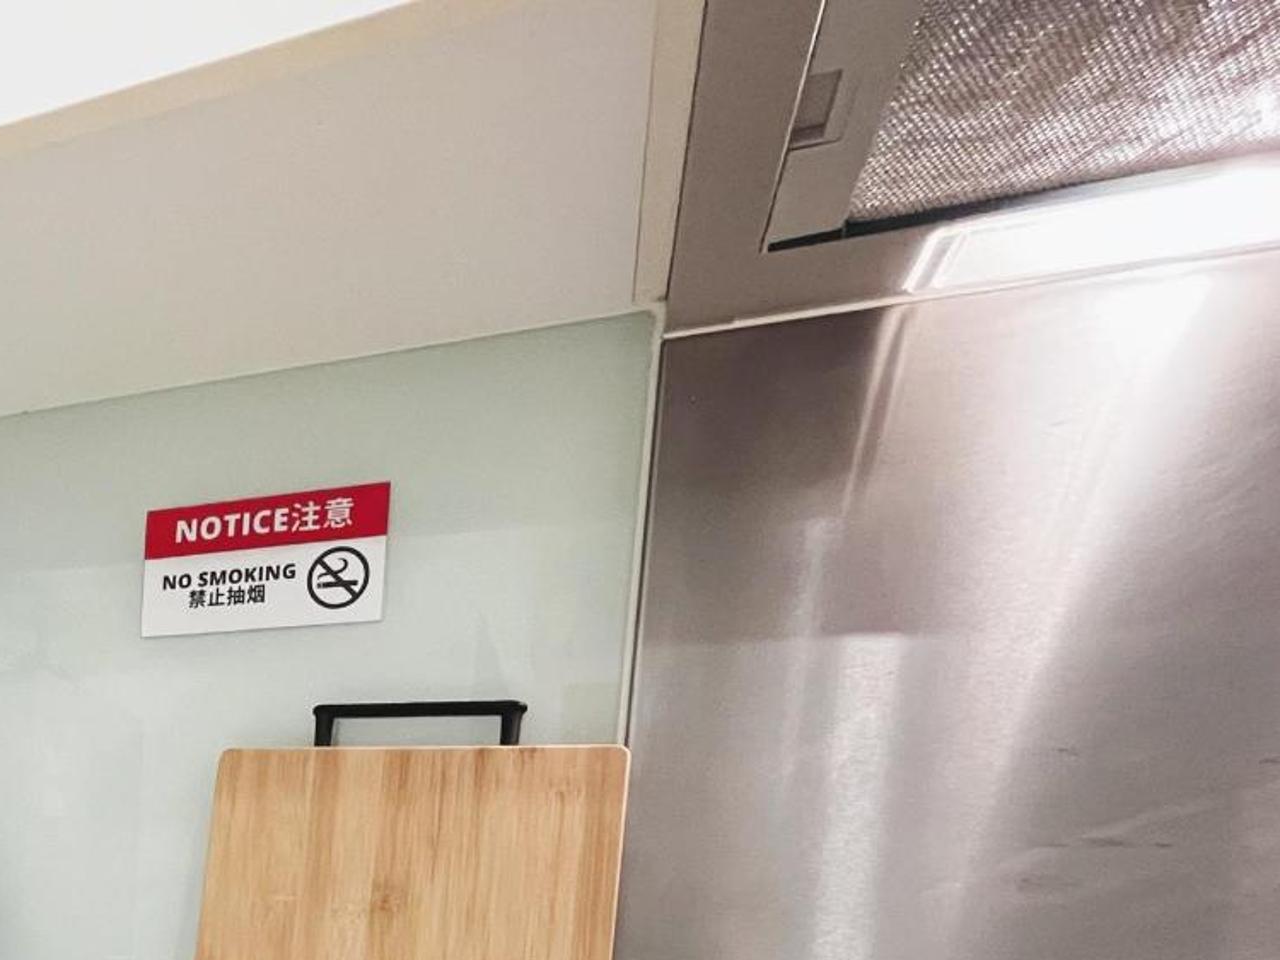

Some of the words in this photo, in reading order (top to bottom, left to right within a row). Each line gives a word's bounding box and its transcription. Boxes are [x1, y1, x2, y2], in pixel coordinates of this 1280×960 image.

[162, 572, 192, 590] NO
[198, 563, 297, 587] SMOKING
[188, 585, 266, 608] 禁止抽烟
